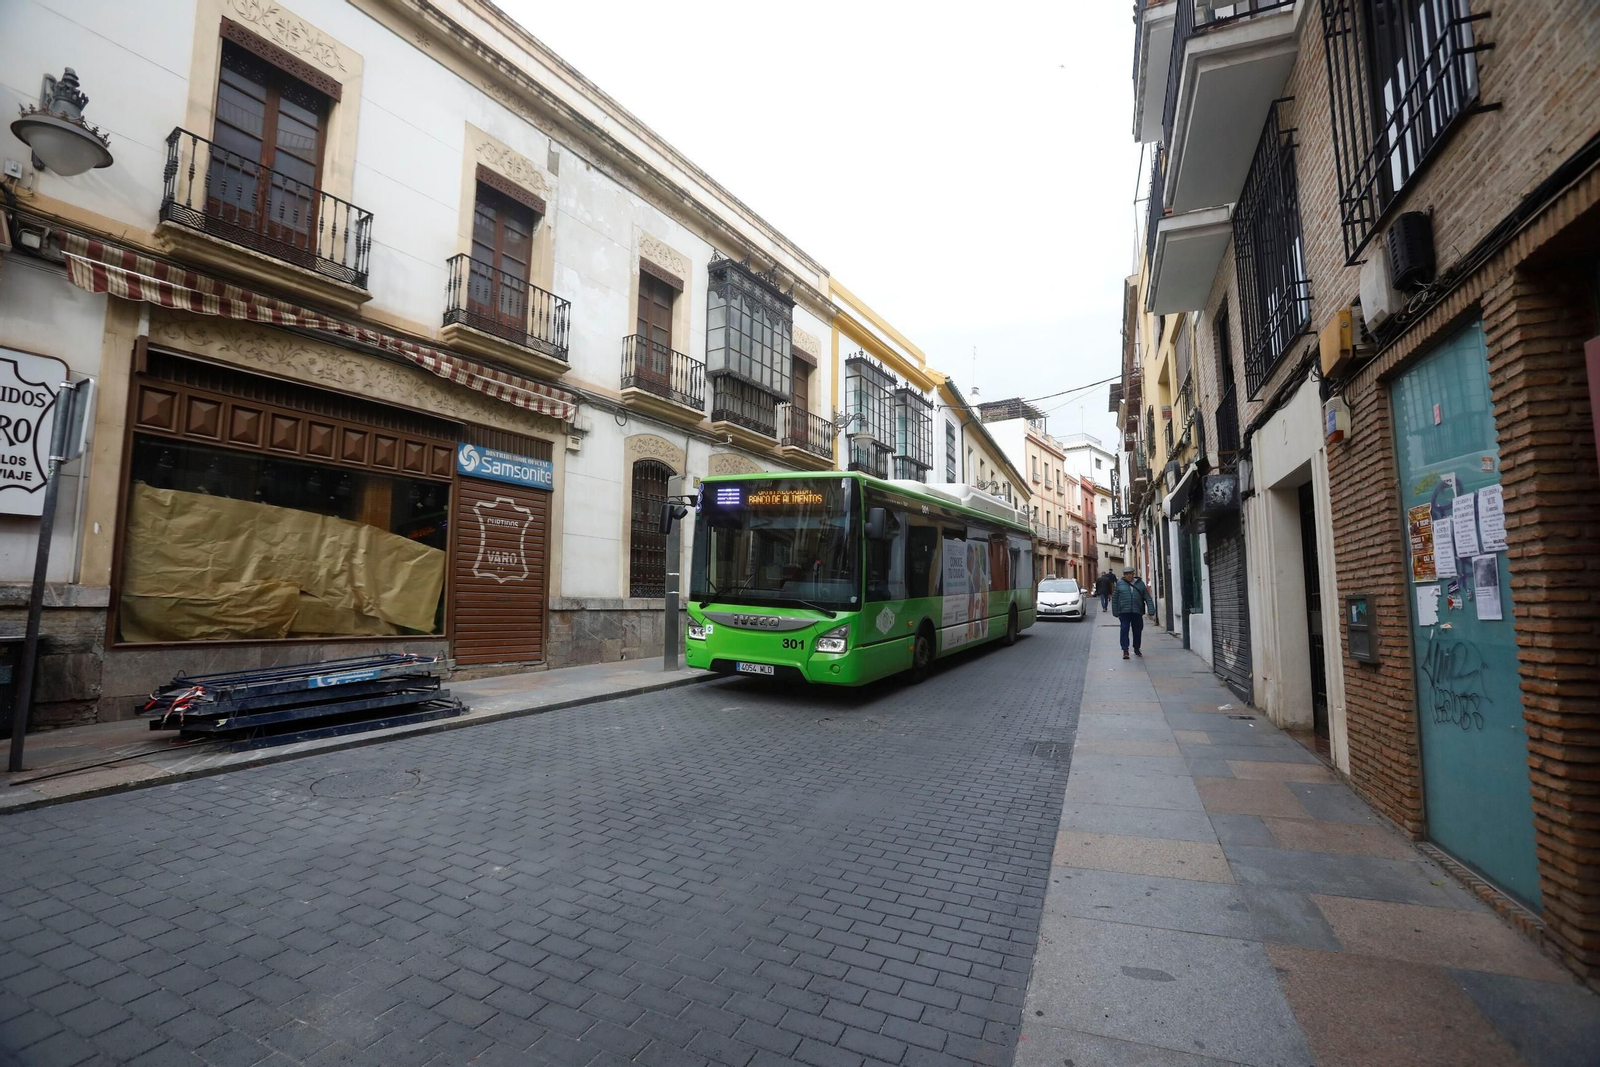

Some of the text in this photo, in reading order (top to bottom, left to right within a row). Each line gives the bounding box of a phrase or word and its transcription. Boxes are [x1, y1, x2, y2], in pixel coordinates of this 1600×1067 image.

[481, 457, 552, 484] Samsonite
[748, 494, 822, 505] BANCO DE ALIMENTOS
[487, 550, 518, 566] VARO
[733, 613, 779, 627] IVECO
[782, 638, 804, 650] 301
[741, 663, 757, 672] 4054
